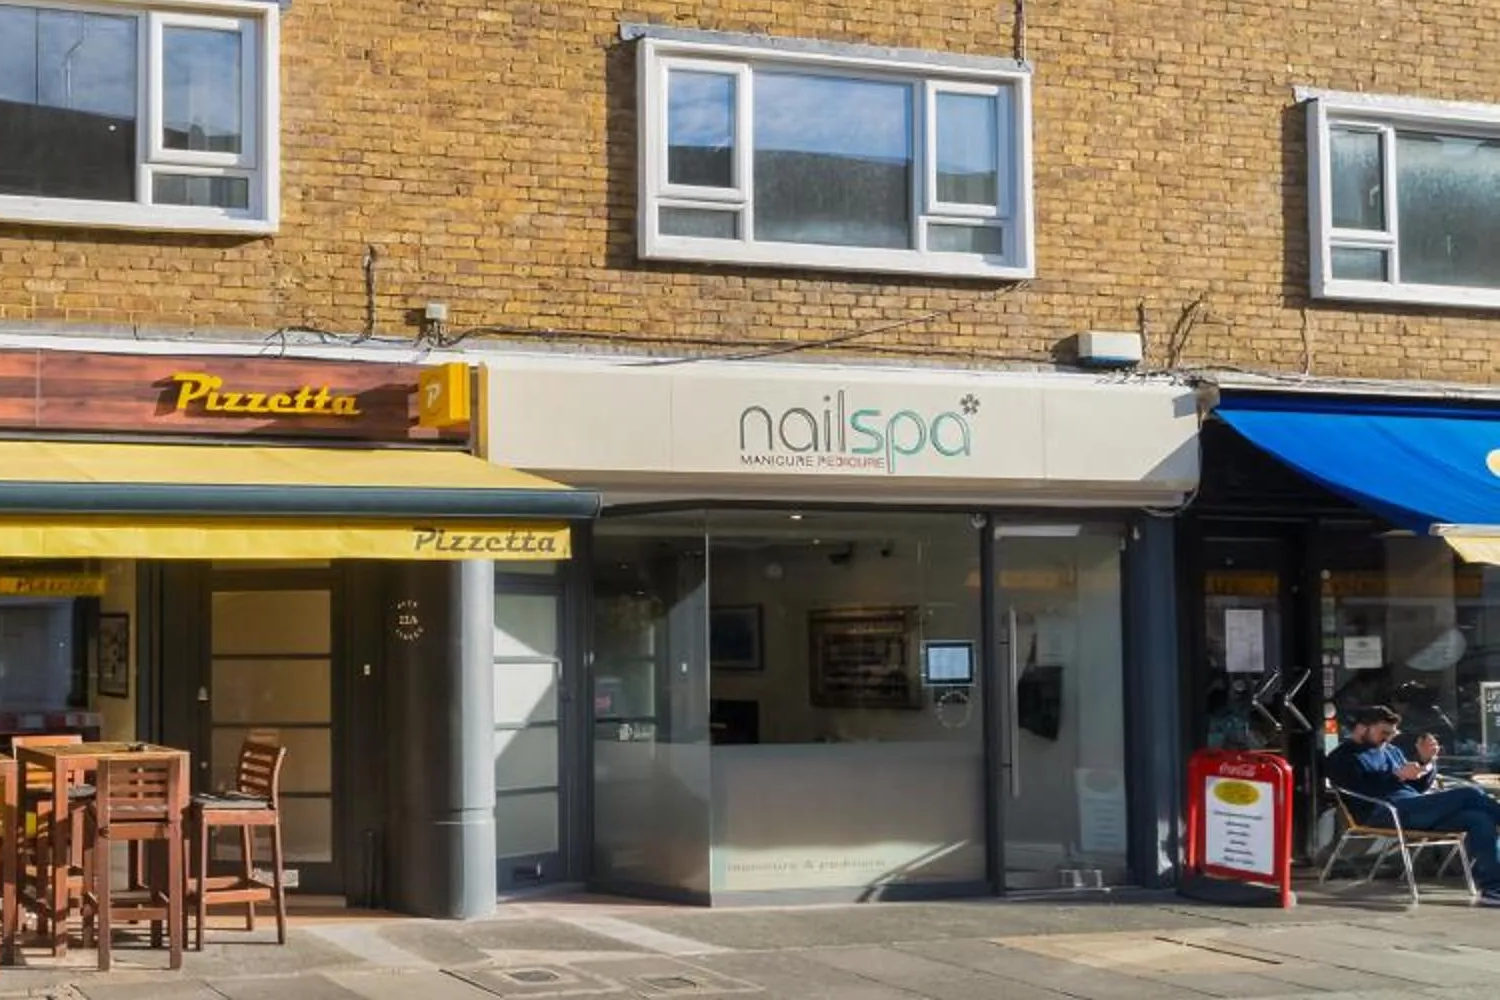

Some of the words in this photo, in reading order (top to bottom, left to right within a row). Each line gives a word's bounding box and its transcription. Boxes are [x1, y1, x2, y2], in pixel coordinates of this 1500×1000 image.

[171, 372, 361, 416] Pizzetta
[740, 390, 971, 474] nailspa
[740, 455, 813, 467] MANICURE
[817, 456, 885, 469] PEDICURE
[412, 527, 556, 554] Pizzetta
